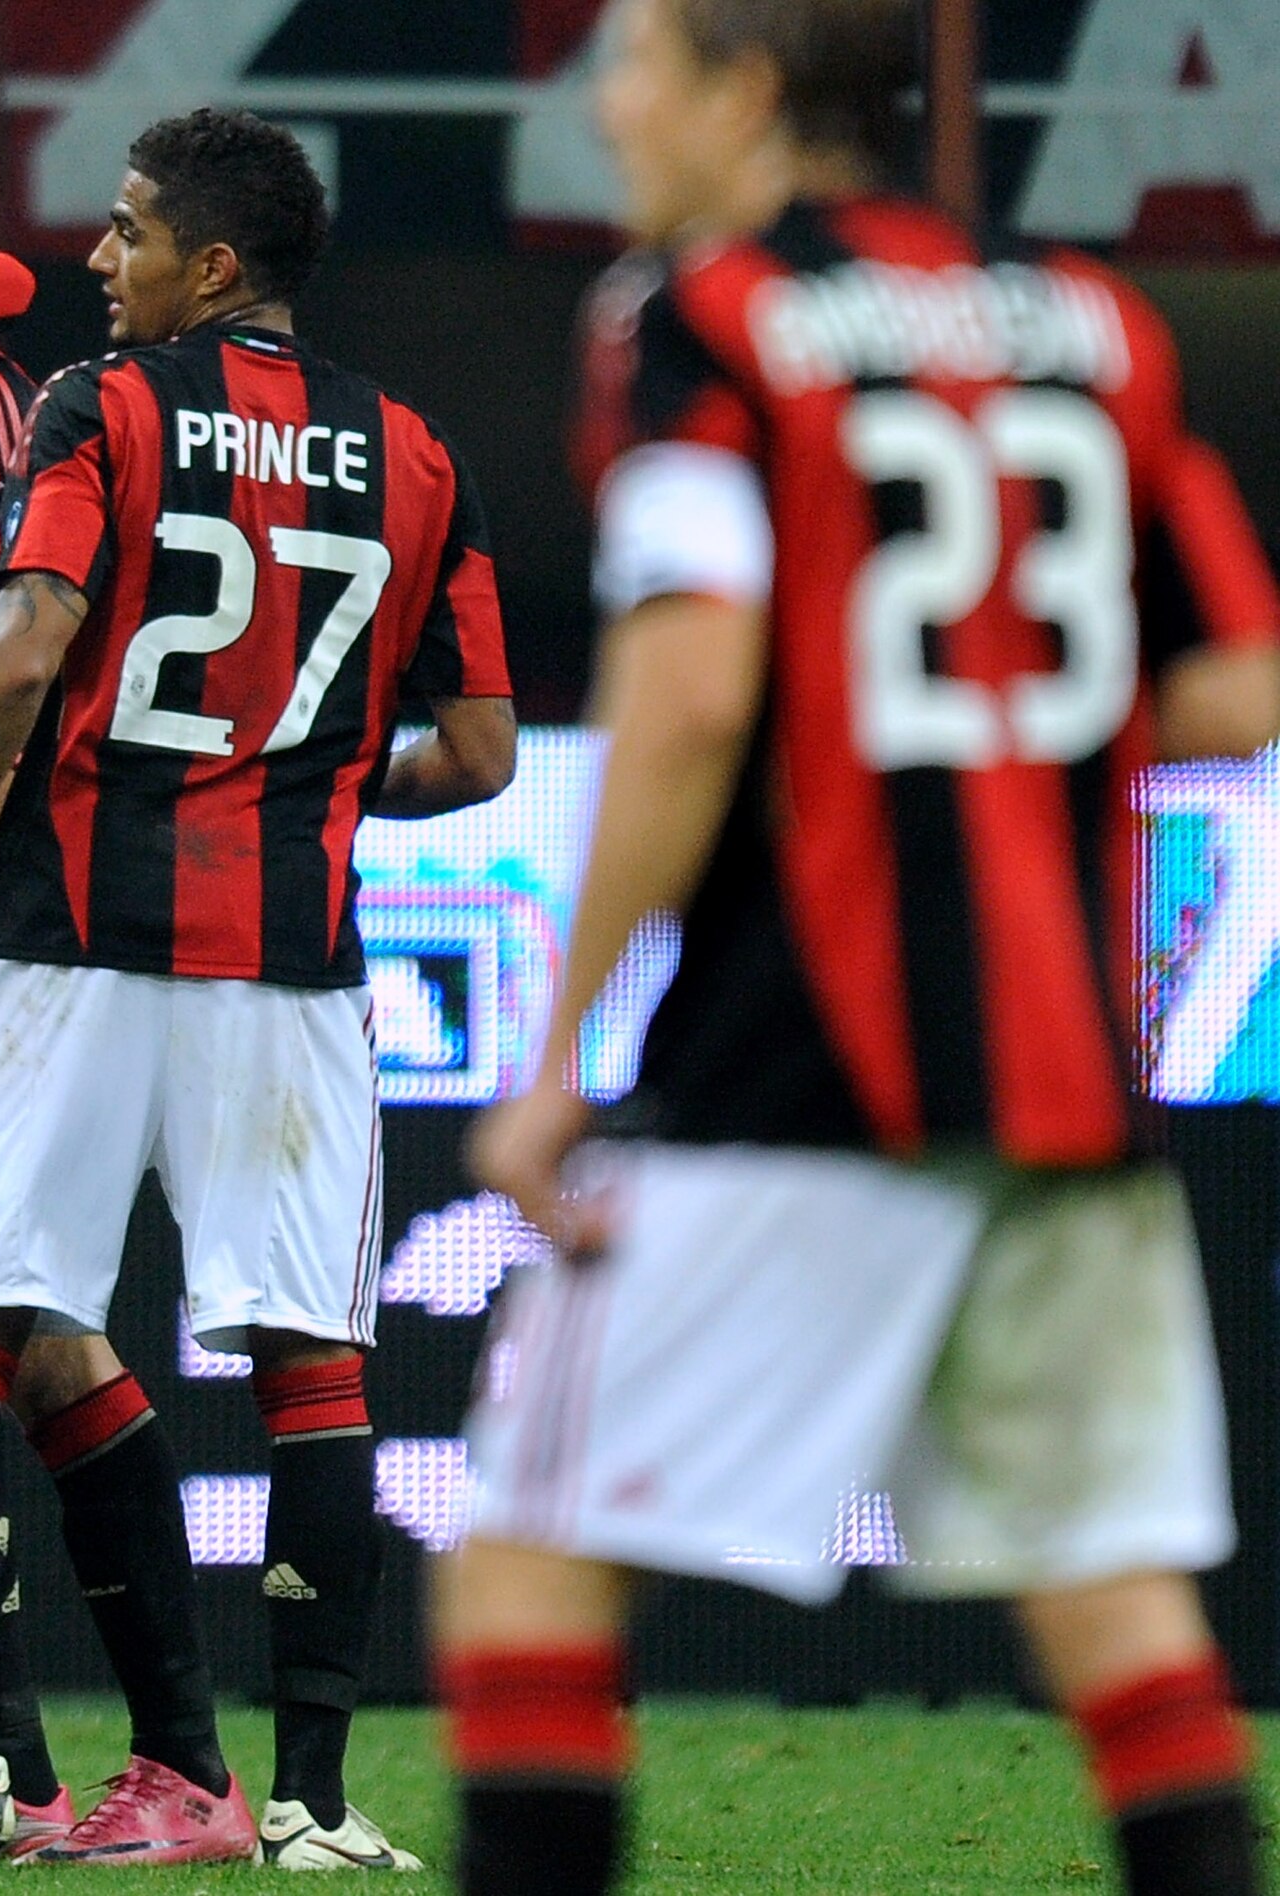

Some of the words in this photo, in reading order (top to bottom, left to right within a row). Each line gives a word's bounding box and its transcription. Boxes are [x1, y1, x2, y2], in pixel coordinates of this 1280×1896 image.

[176, 408, 368, 494] PRINCE
[109, 511, 392, 756] 27
[840, 386, 1138, 772] 23
